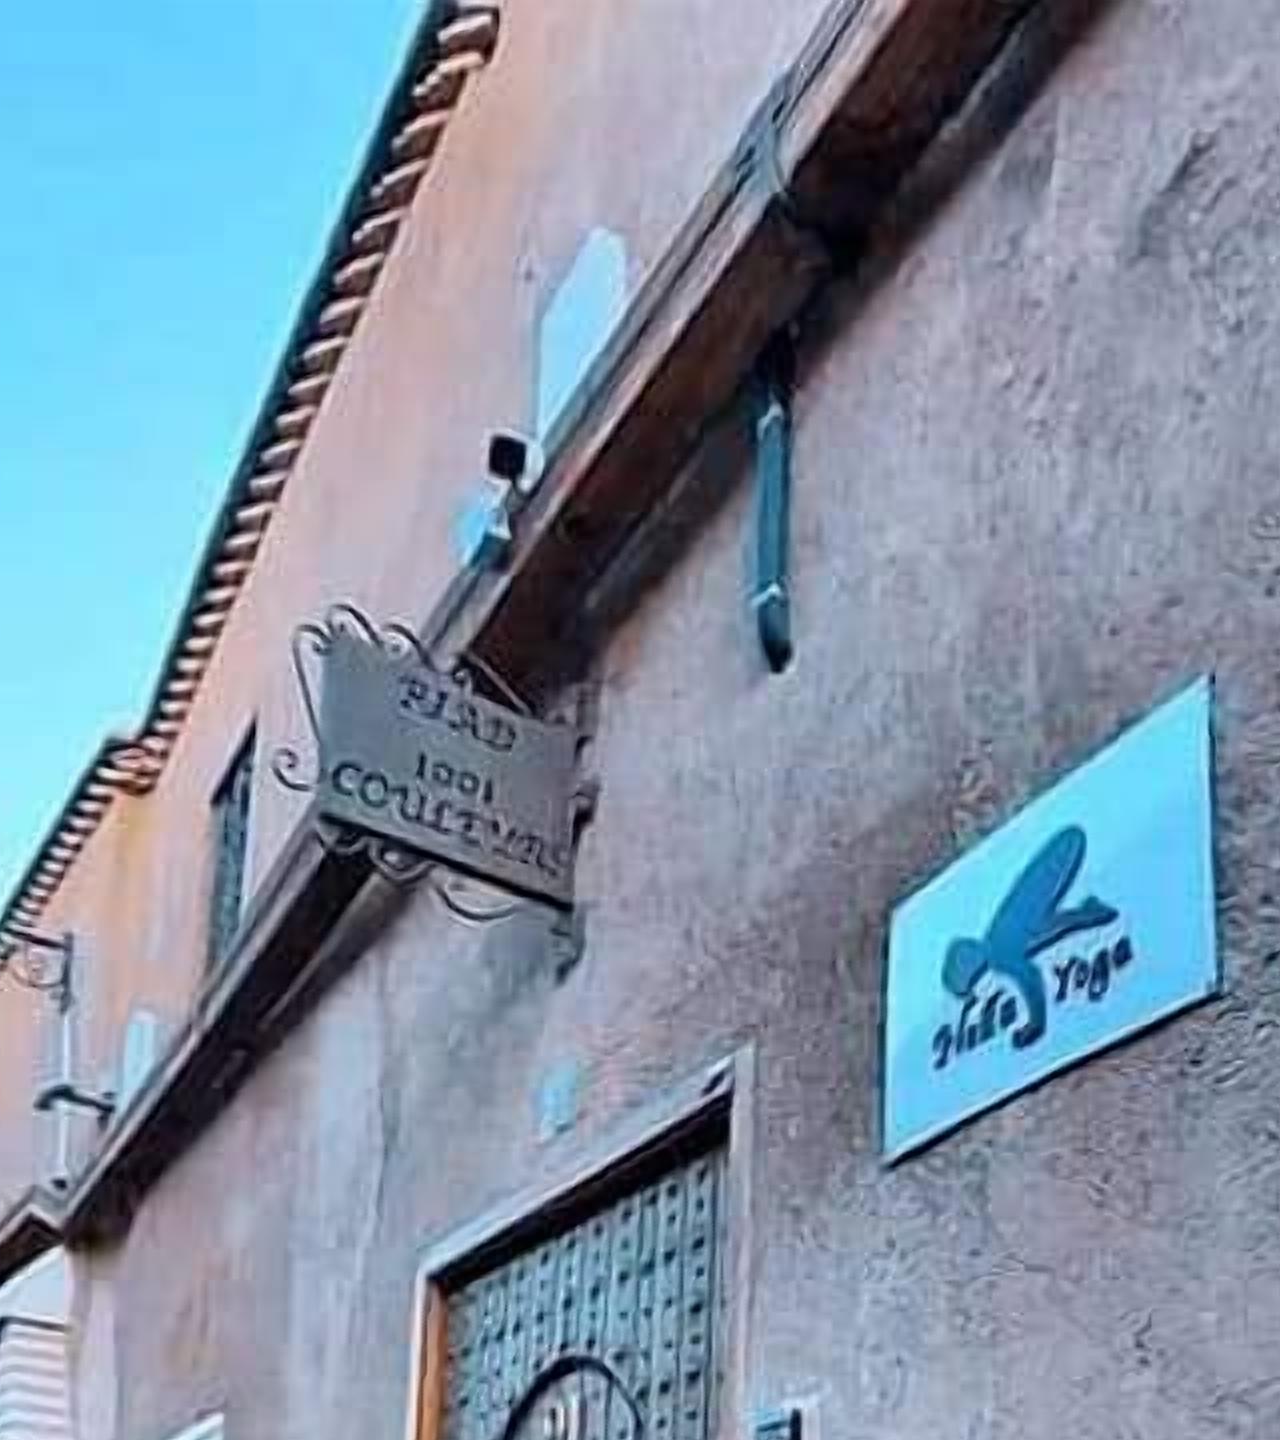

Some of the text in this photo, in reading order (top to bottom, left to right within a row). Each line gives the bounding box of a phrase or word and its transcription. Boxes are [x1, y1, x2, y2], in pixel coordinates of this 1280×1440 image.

[400, 676, 517, 752] RIAD
[417, 753, 494, 804] 1001
[1053, 937, 1133, 1003] Yoga
